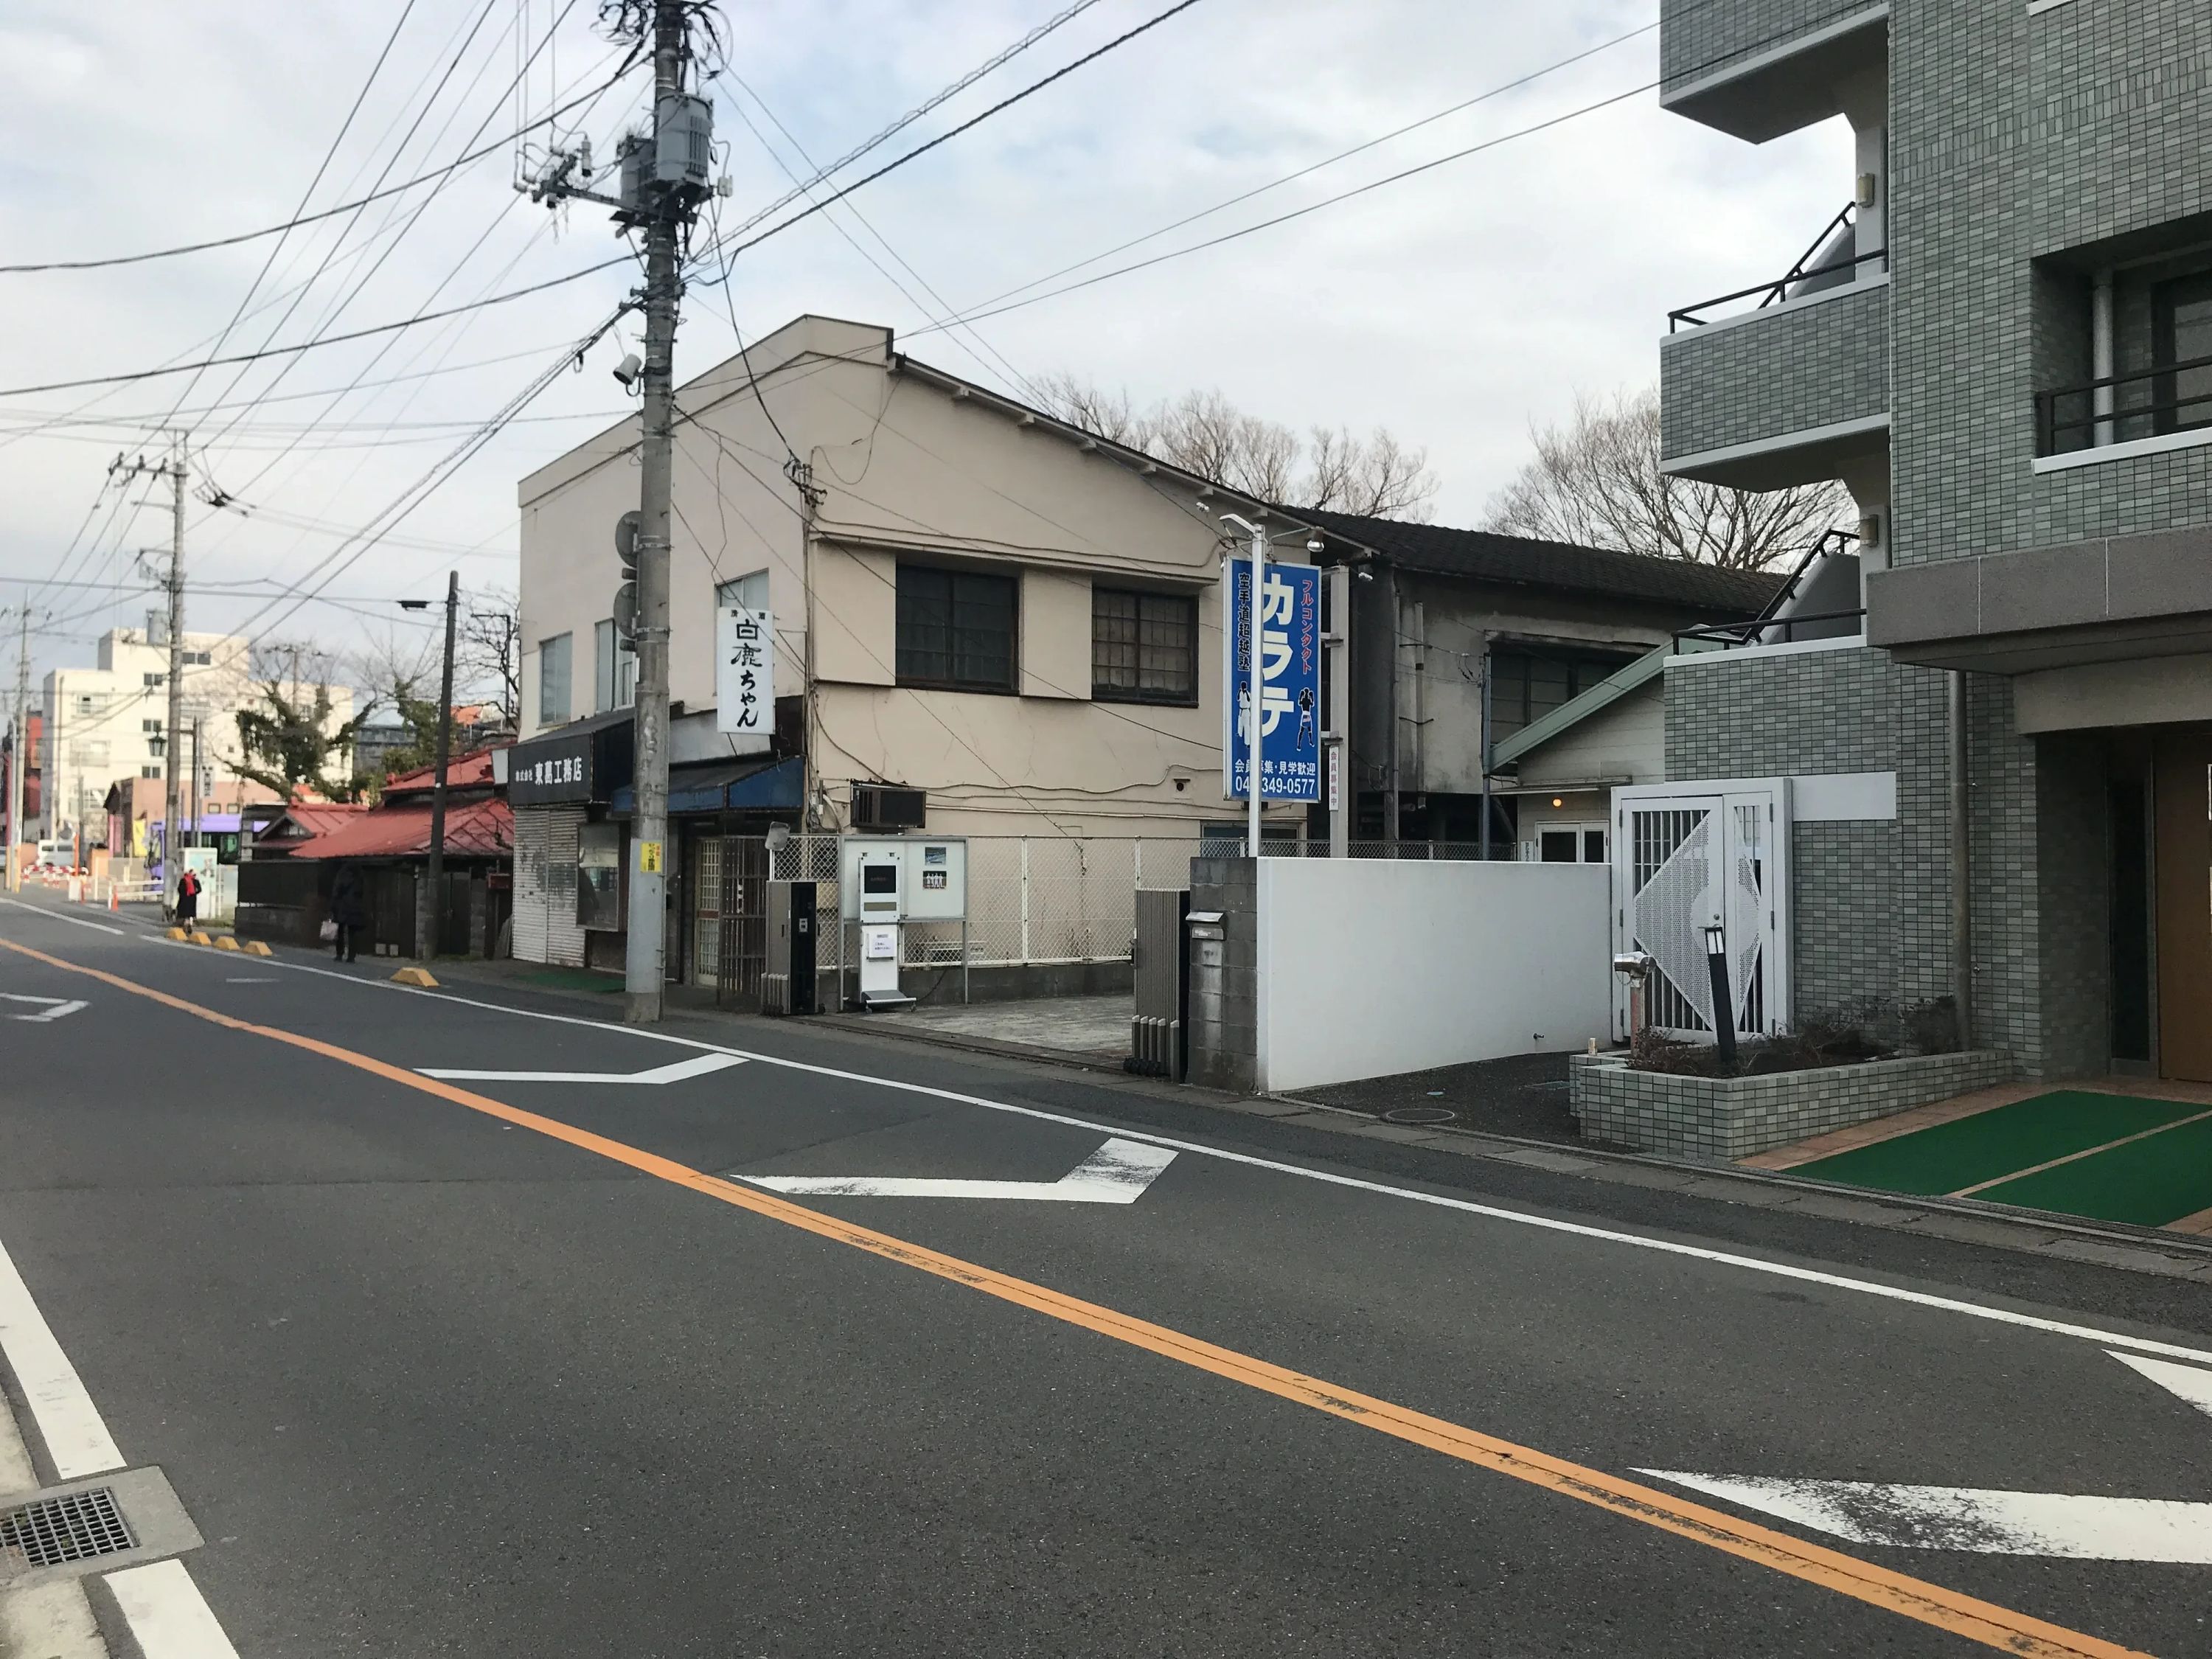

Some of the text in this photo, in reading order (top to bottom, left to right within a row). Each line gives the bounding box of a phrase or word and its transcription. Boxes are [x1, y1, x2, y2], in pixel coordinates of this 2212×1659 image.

[731, 619, 762, 727] 白鹿ちゃん
[1262, 573, 1295, 737] カラテ
[1301, 580, 1314, 675] フルコンタクト
